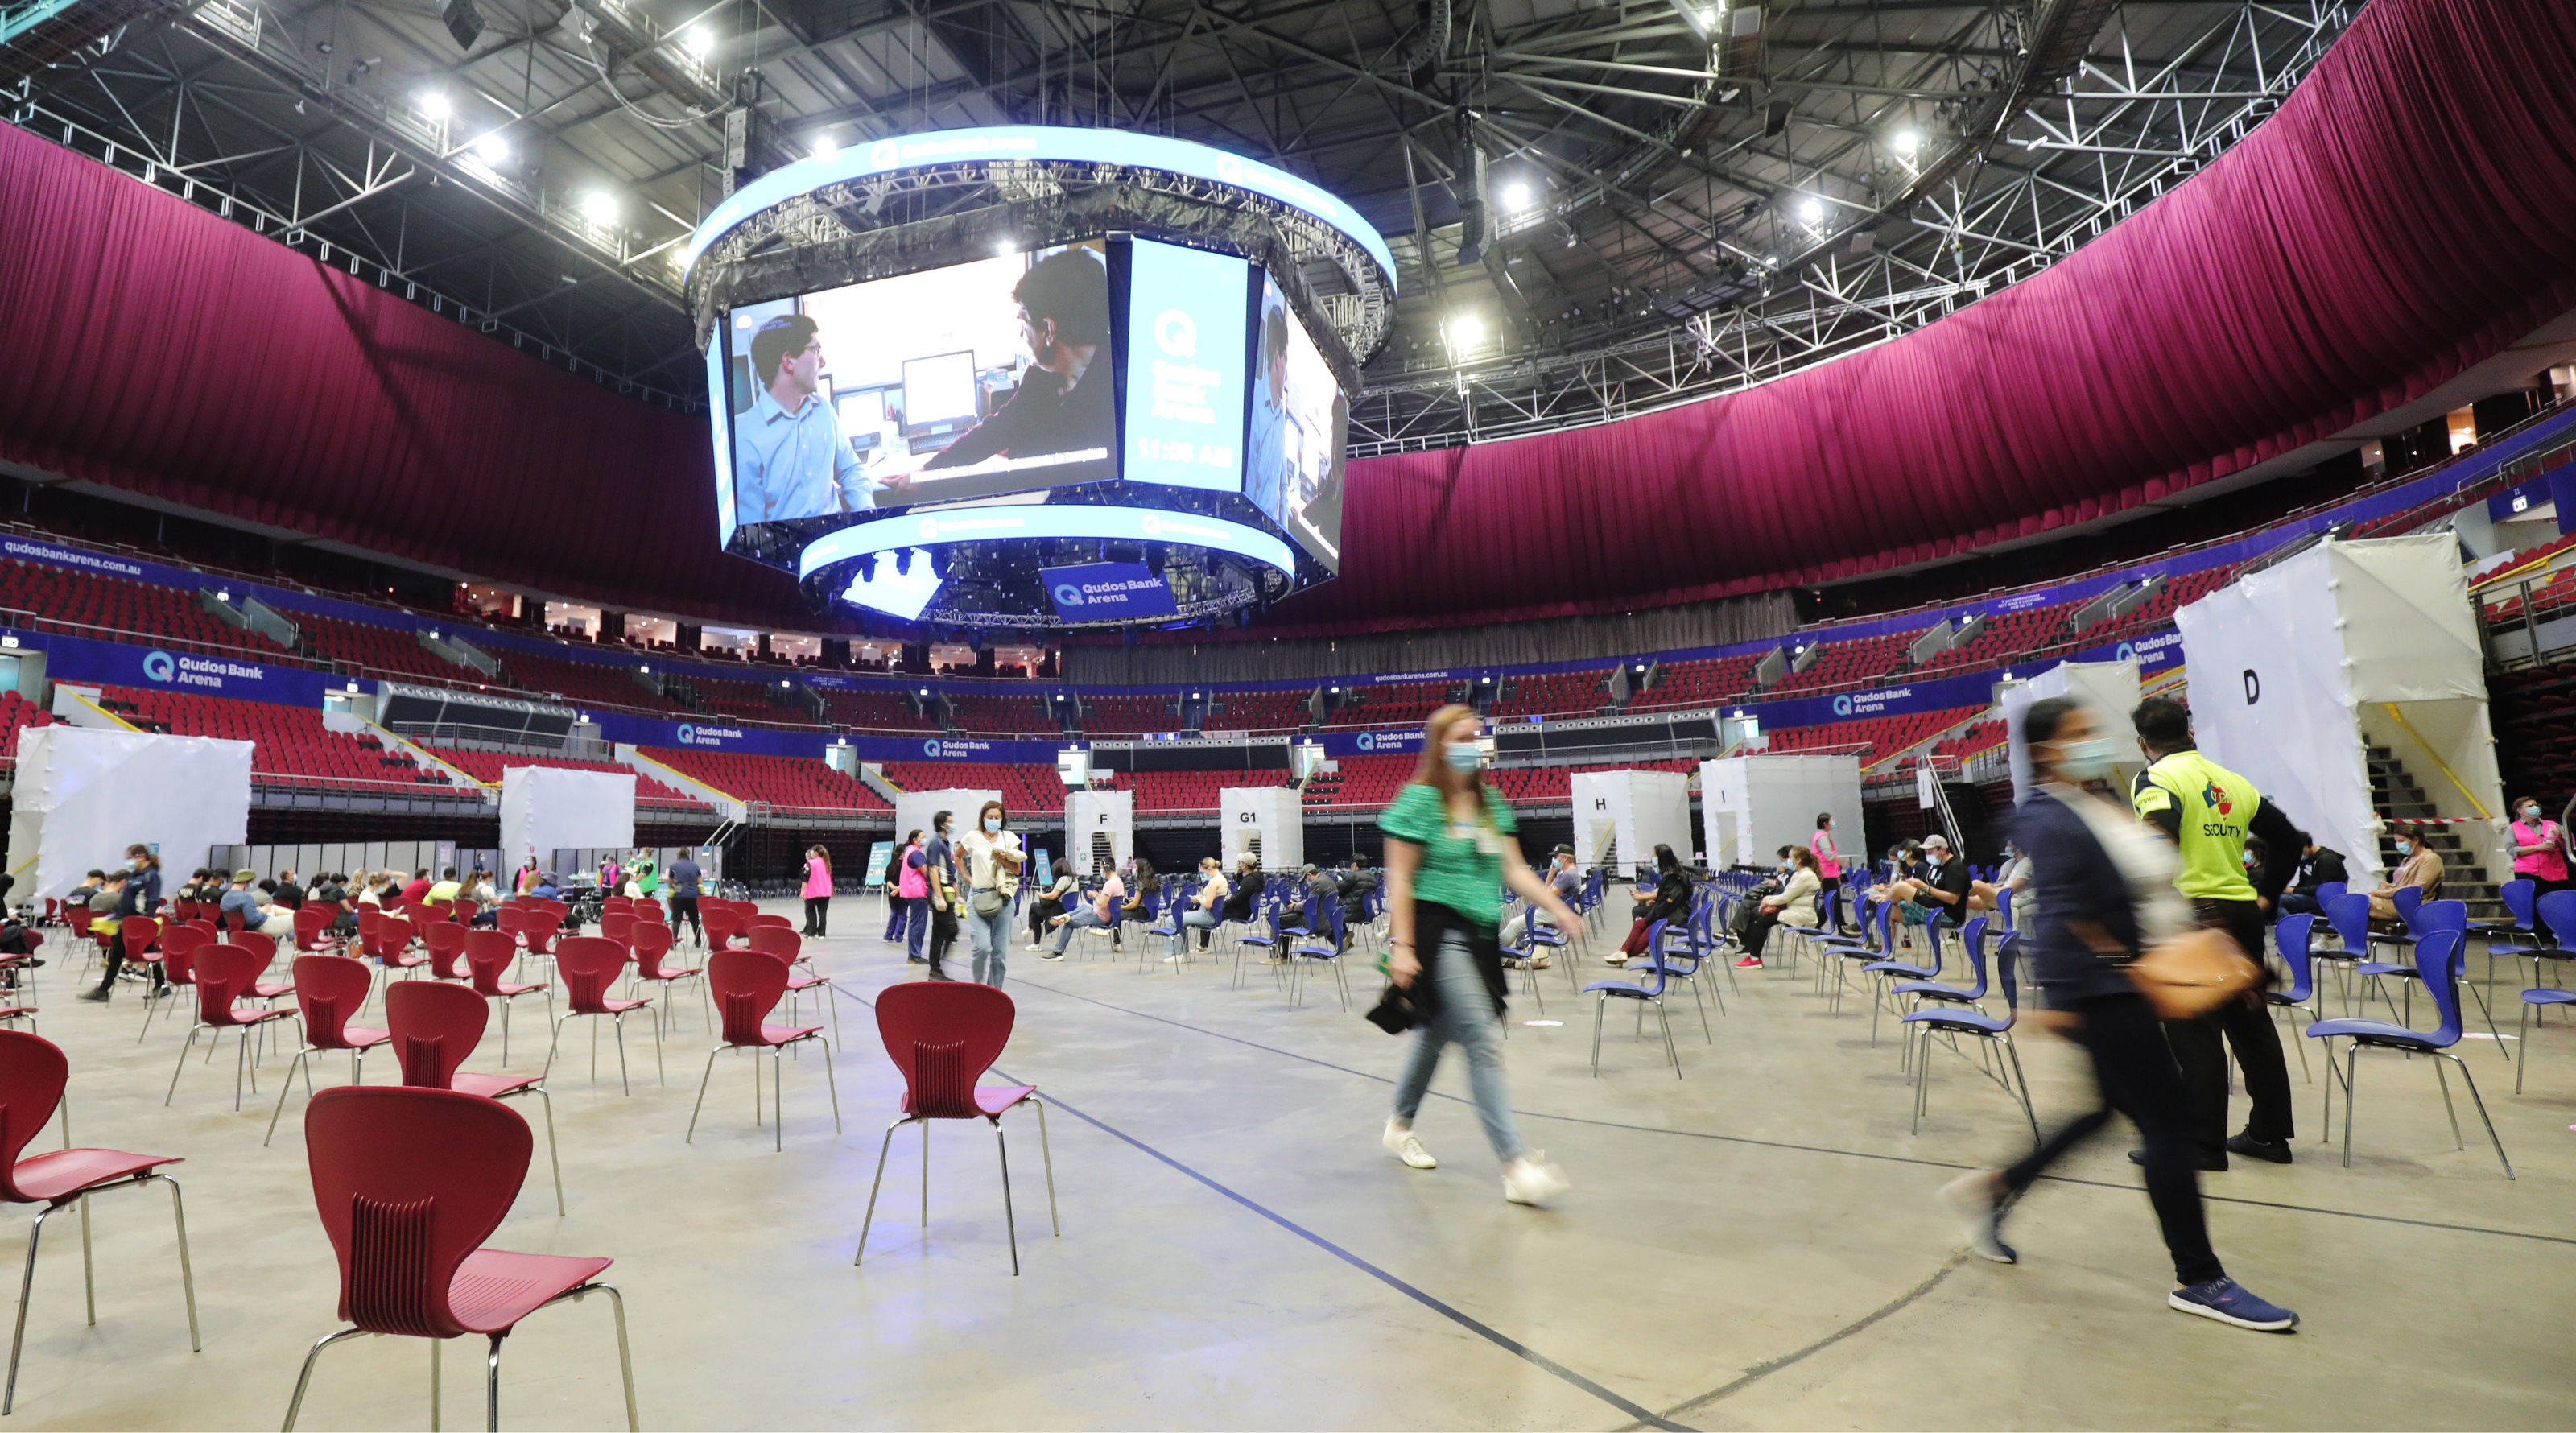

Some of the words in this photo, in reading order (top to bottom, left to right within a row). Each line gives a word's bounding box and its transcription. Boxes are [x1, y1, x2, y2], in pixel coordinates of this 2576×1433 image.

[5, 542, 141, 576] qudosbankarena.com.au
[1083, 582, 1126, 594] Qudos
[1127, 577, 1163, 590] Bank
[1088, 593, 1128, 604] Arena
[2135, 638, 2165, 652] Qudos
[2137, 650, 2165, 665] Arena
[179, 657, 227, 675] Qudos
[228, 664, 263, 679] Bank
[177, 671, 222, 688] Arena
[1375, 671, 1448, 683] qudosbankarena.com.au
[2244, 668, 2260, 705] D
[1853, 692, 1885, 704] Qudos
[1885, 688, 1912, 700] Bank
[1855, 703, 1885, 713] Arena
[696, 726, 722, 737] Qudos
[723, 729, 743, 738] Bank
[1376, 733, 1403, 741] Qudos
[1404, 732, 1426, 740] Bank
[696, 736, 720, 745] Arena
[969, 741, 989, 750] Bank
[1596, 798, 1606, 810] H
[1100, 814, 1108, 824] F
[1240, 812, 1256, 823] G1
